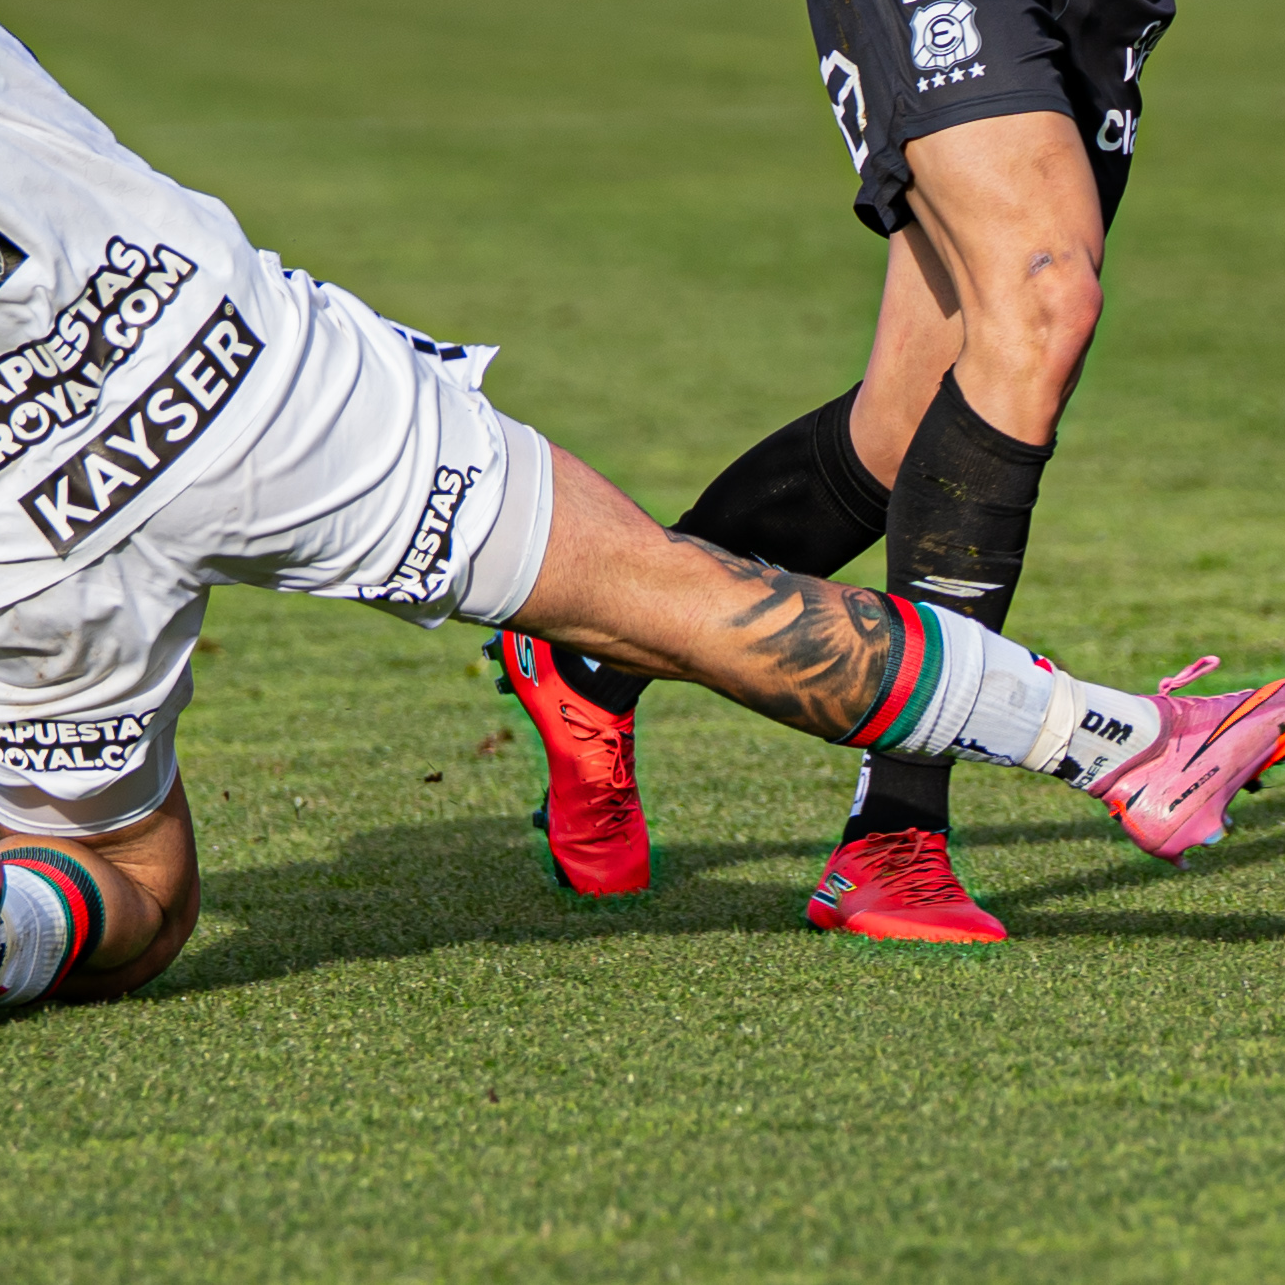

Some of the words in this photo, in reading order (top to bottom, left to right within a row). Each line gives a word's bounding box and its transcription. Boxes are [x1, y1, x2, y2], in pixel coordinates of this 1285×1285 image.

[1096, 109, 1140, 155] Cla
[33, 320, 254, 542] KAYSER
[1080, 709, 1133, 745] DM
